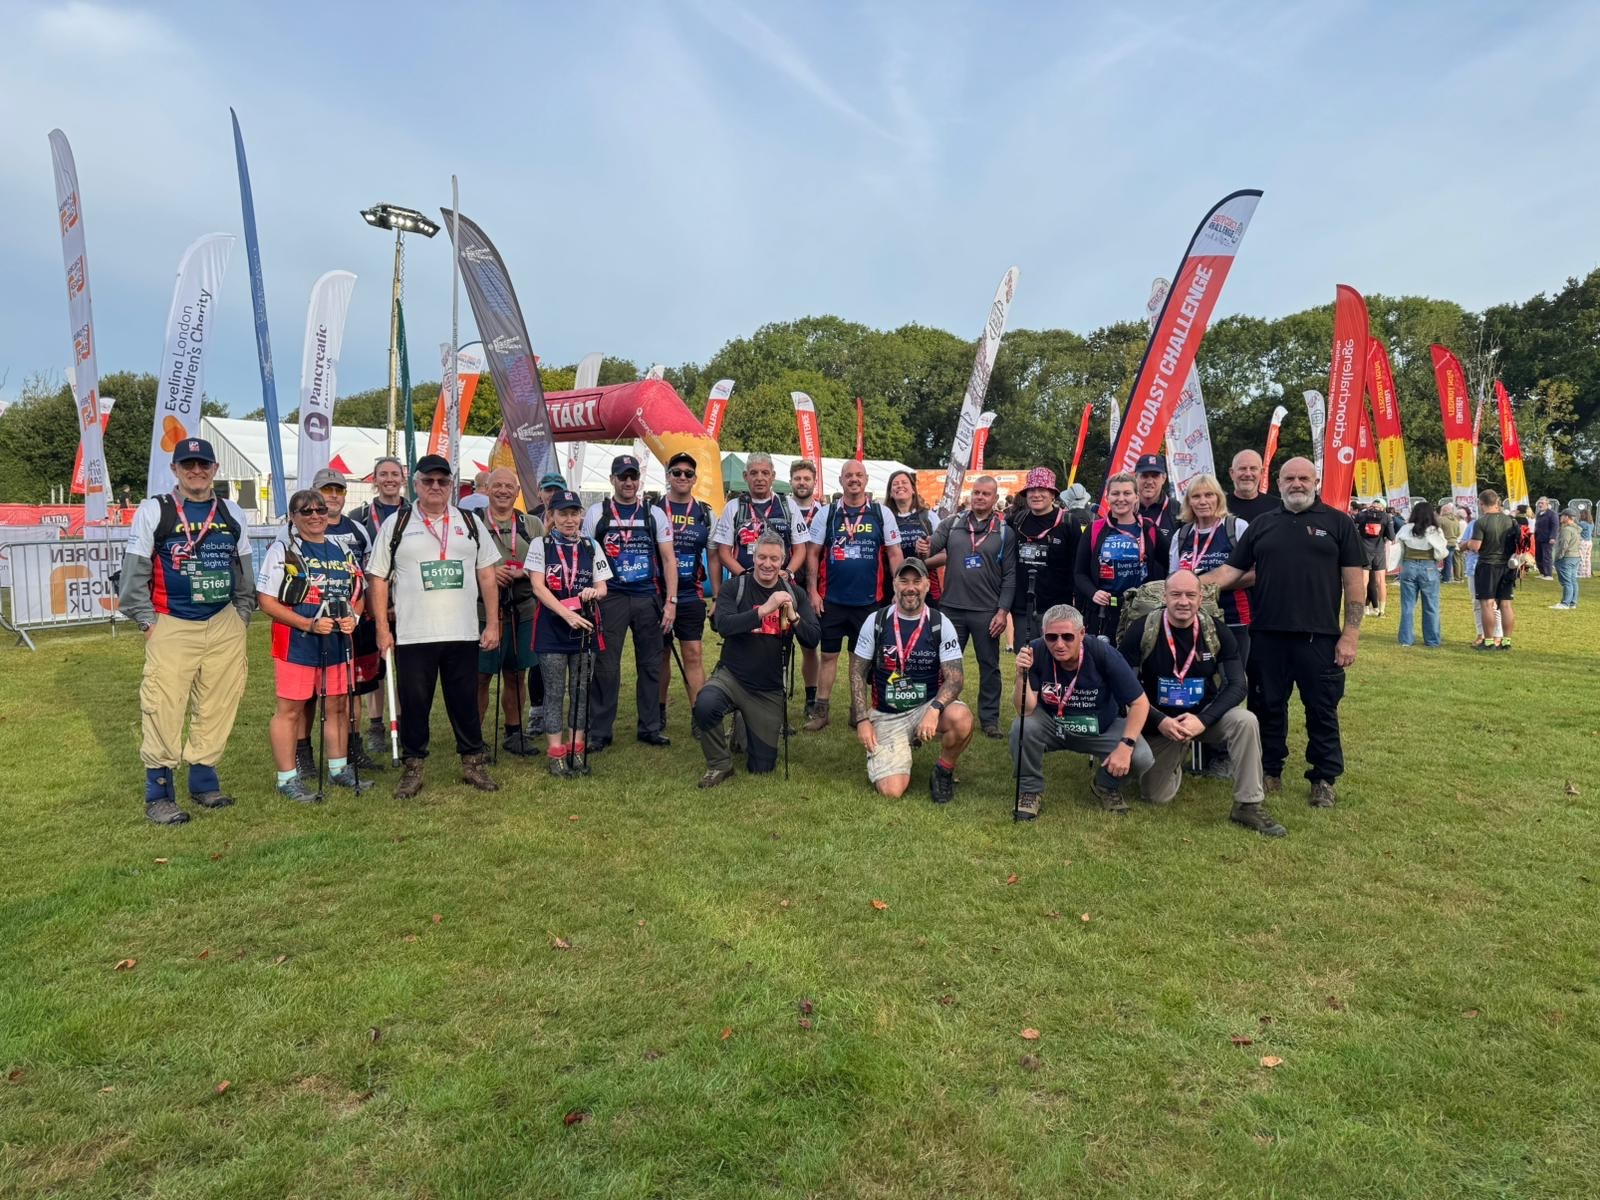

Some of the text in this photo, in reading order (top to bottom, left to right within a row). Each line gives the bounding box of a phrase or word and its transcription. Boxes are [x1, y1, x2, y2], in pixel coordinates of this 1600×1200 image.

[178, 288, 212, 414] Children's Charity
[1136, 375, 1168, 436] COAST
[1159, 263, 1213, 376] CHALLENGE
[165, 306, 192, 412] Evelina London
[310, 324, 328, 407] Pancreatic
[706, 402, 720, 438] ALLENGE
[42, 515, 69, 524] ULTRA
[672, 515, 695, 525] IDE
[838, 524, 872, 532] GIDE
[431, 568, 454, 576] 5170
[202, 580, 224, 589] 5166
[1064, 724, 1088, 733] 5236
